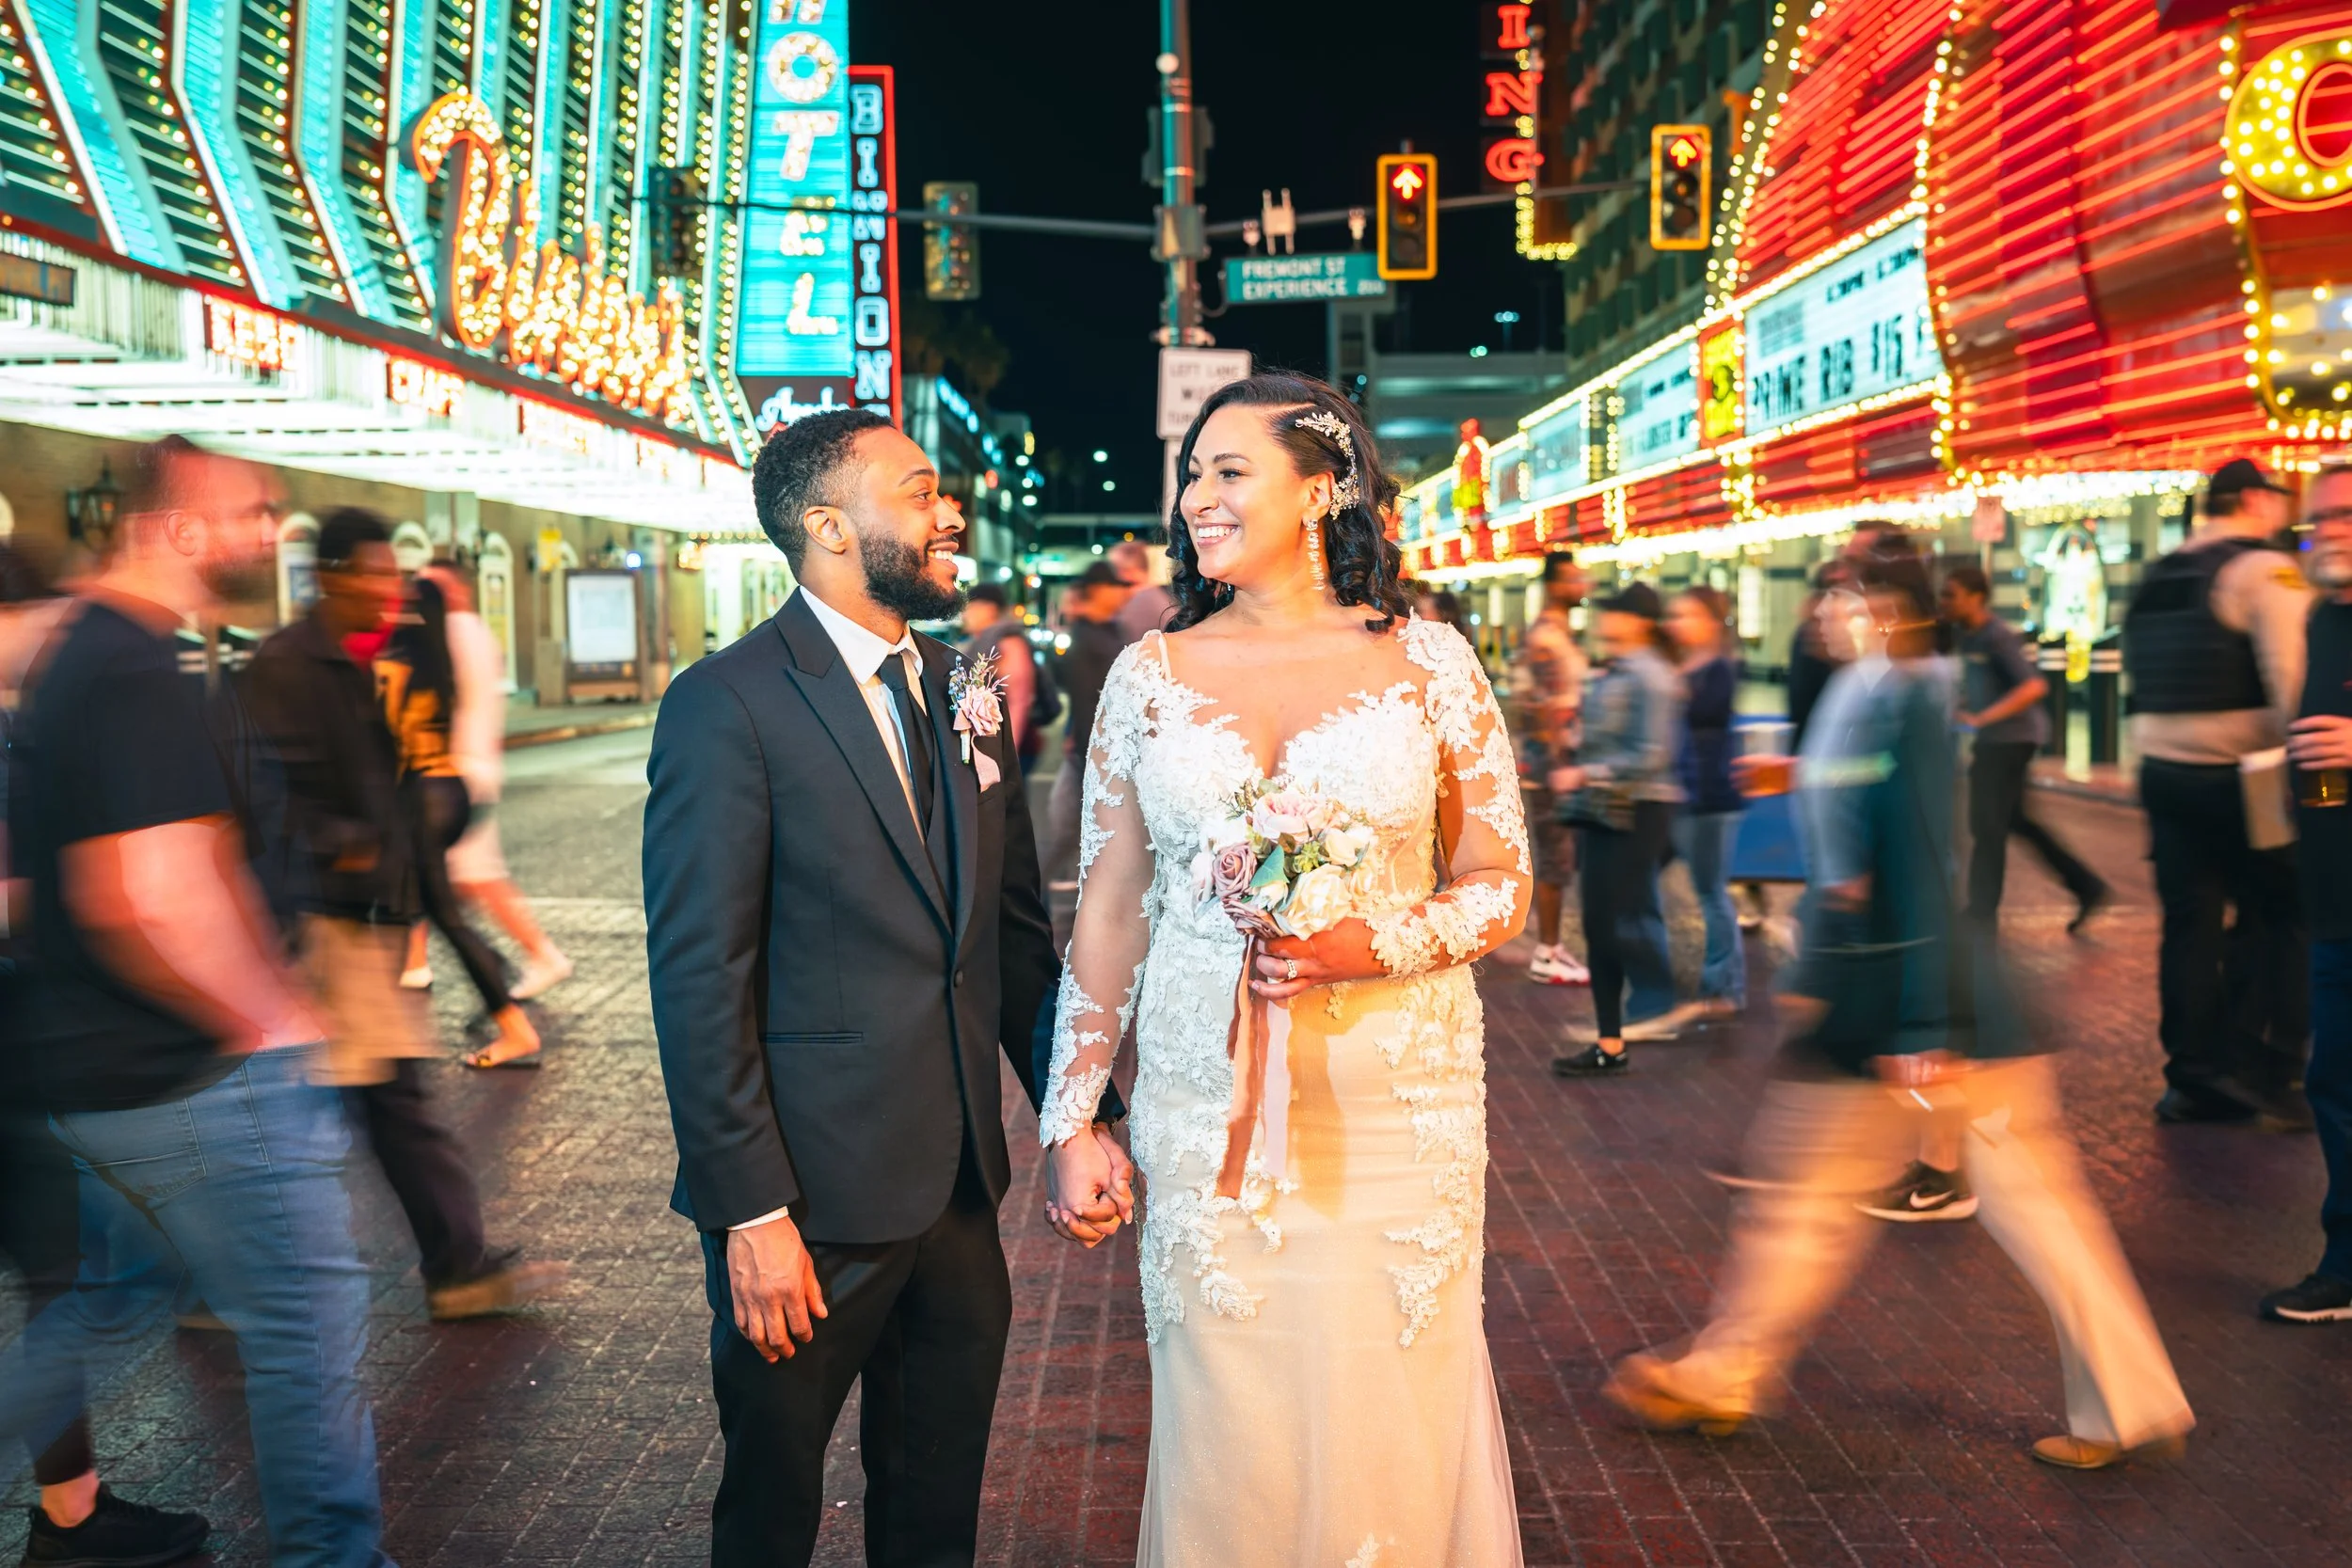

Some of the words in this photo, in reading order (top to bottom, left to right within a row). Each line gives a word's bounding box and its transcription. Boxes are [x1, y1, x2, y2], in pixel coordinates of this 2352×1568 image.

[1242, 258, 1321, 278] FREMONT
[1325, 256, 1345, 277] ST
[1242, 277, 1348, 300] EXPERIENCE
